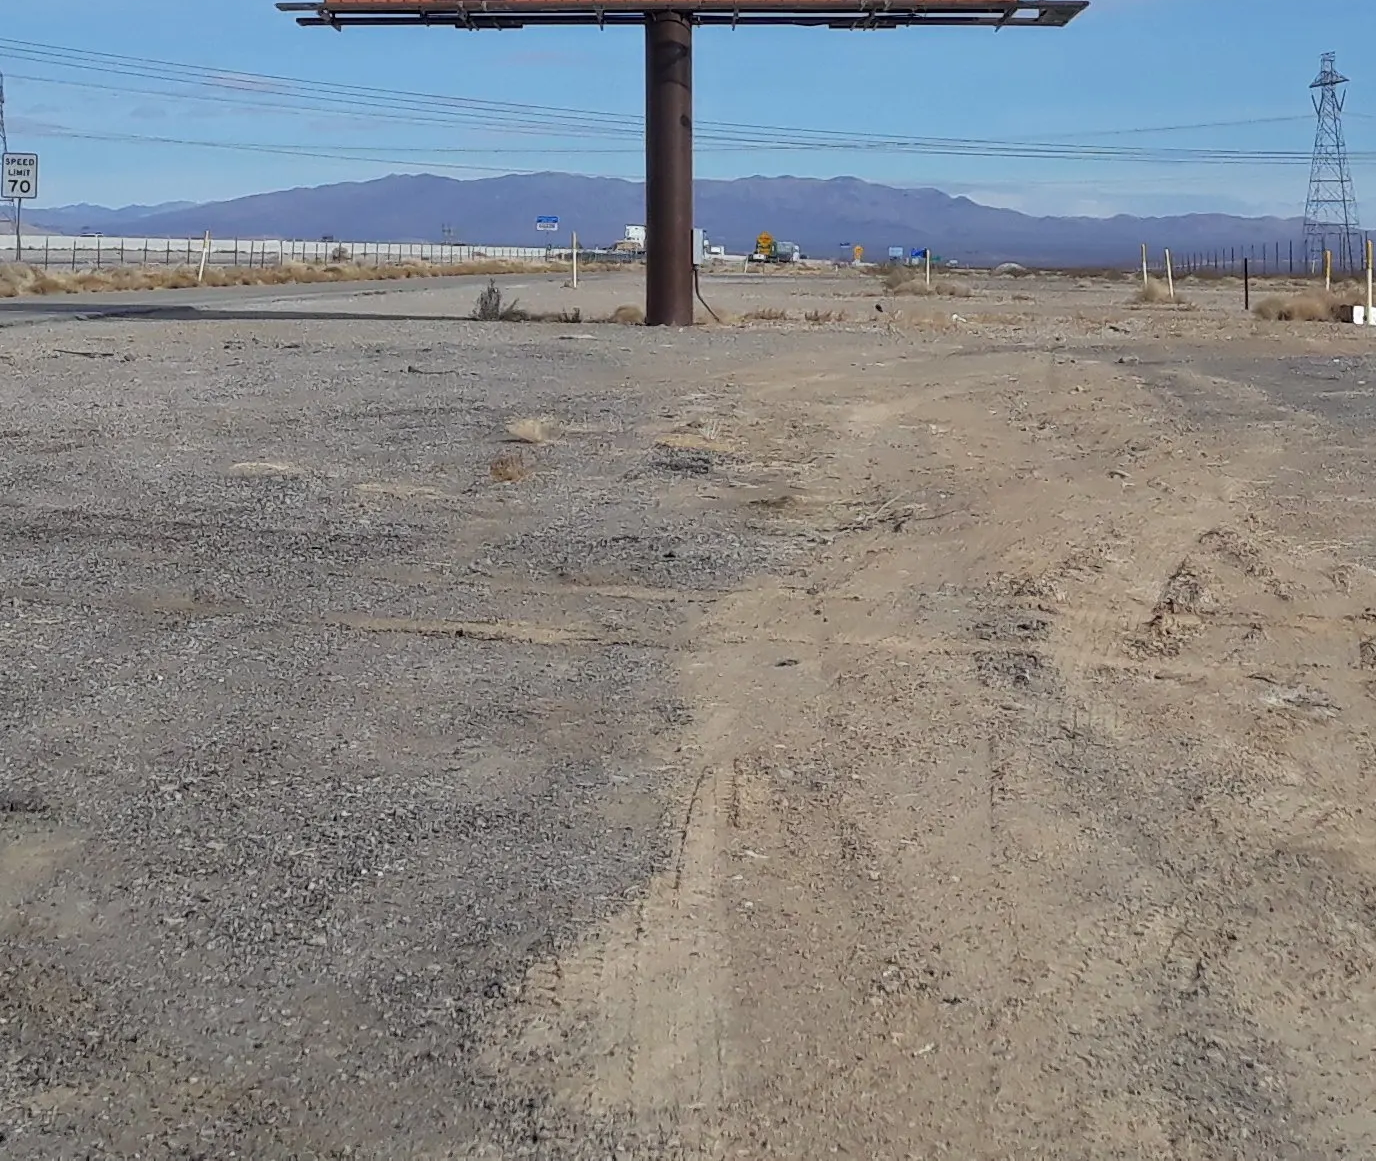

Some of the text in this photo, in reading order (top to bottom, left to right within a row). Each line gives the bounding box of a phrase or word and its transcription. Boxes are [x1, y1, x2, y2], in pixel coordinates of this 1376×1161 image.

[4, 158, 35, 167] SPEED
[8, 169, 31, 177] LIMIT
[7, 179, 31, 194] 70
